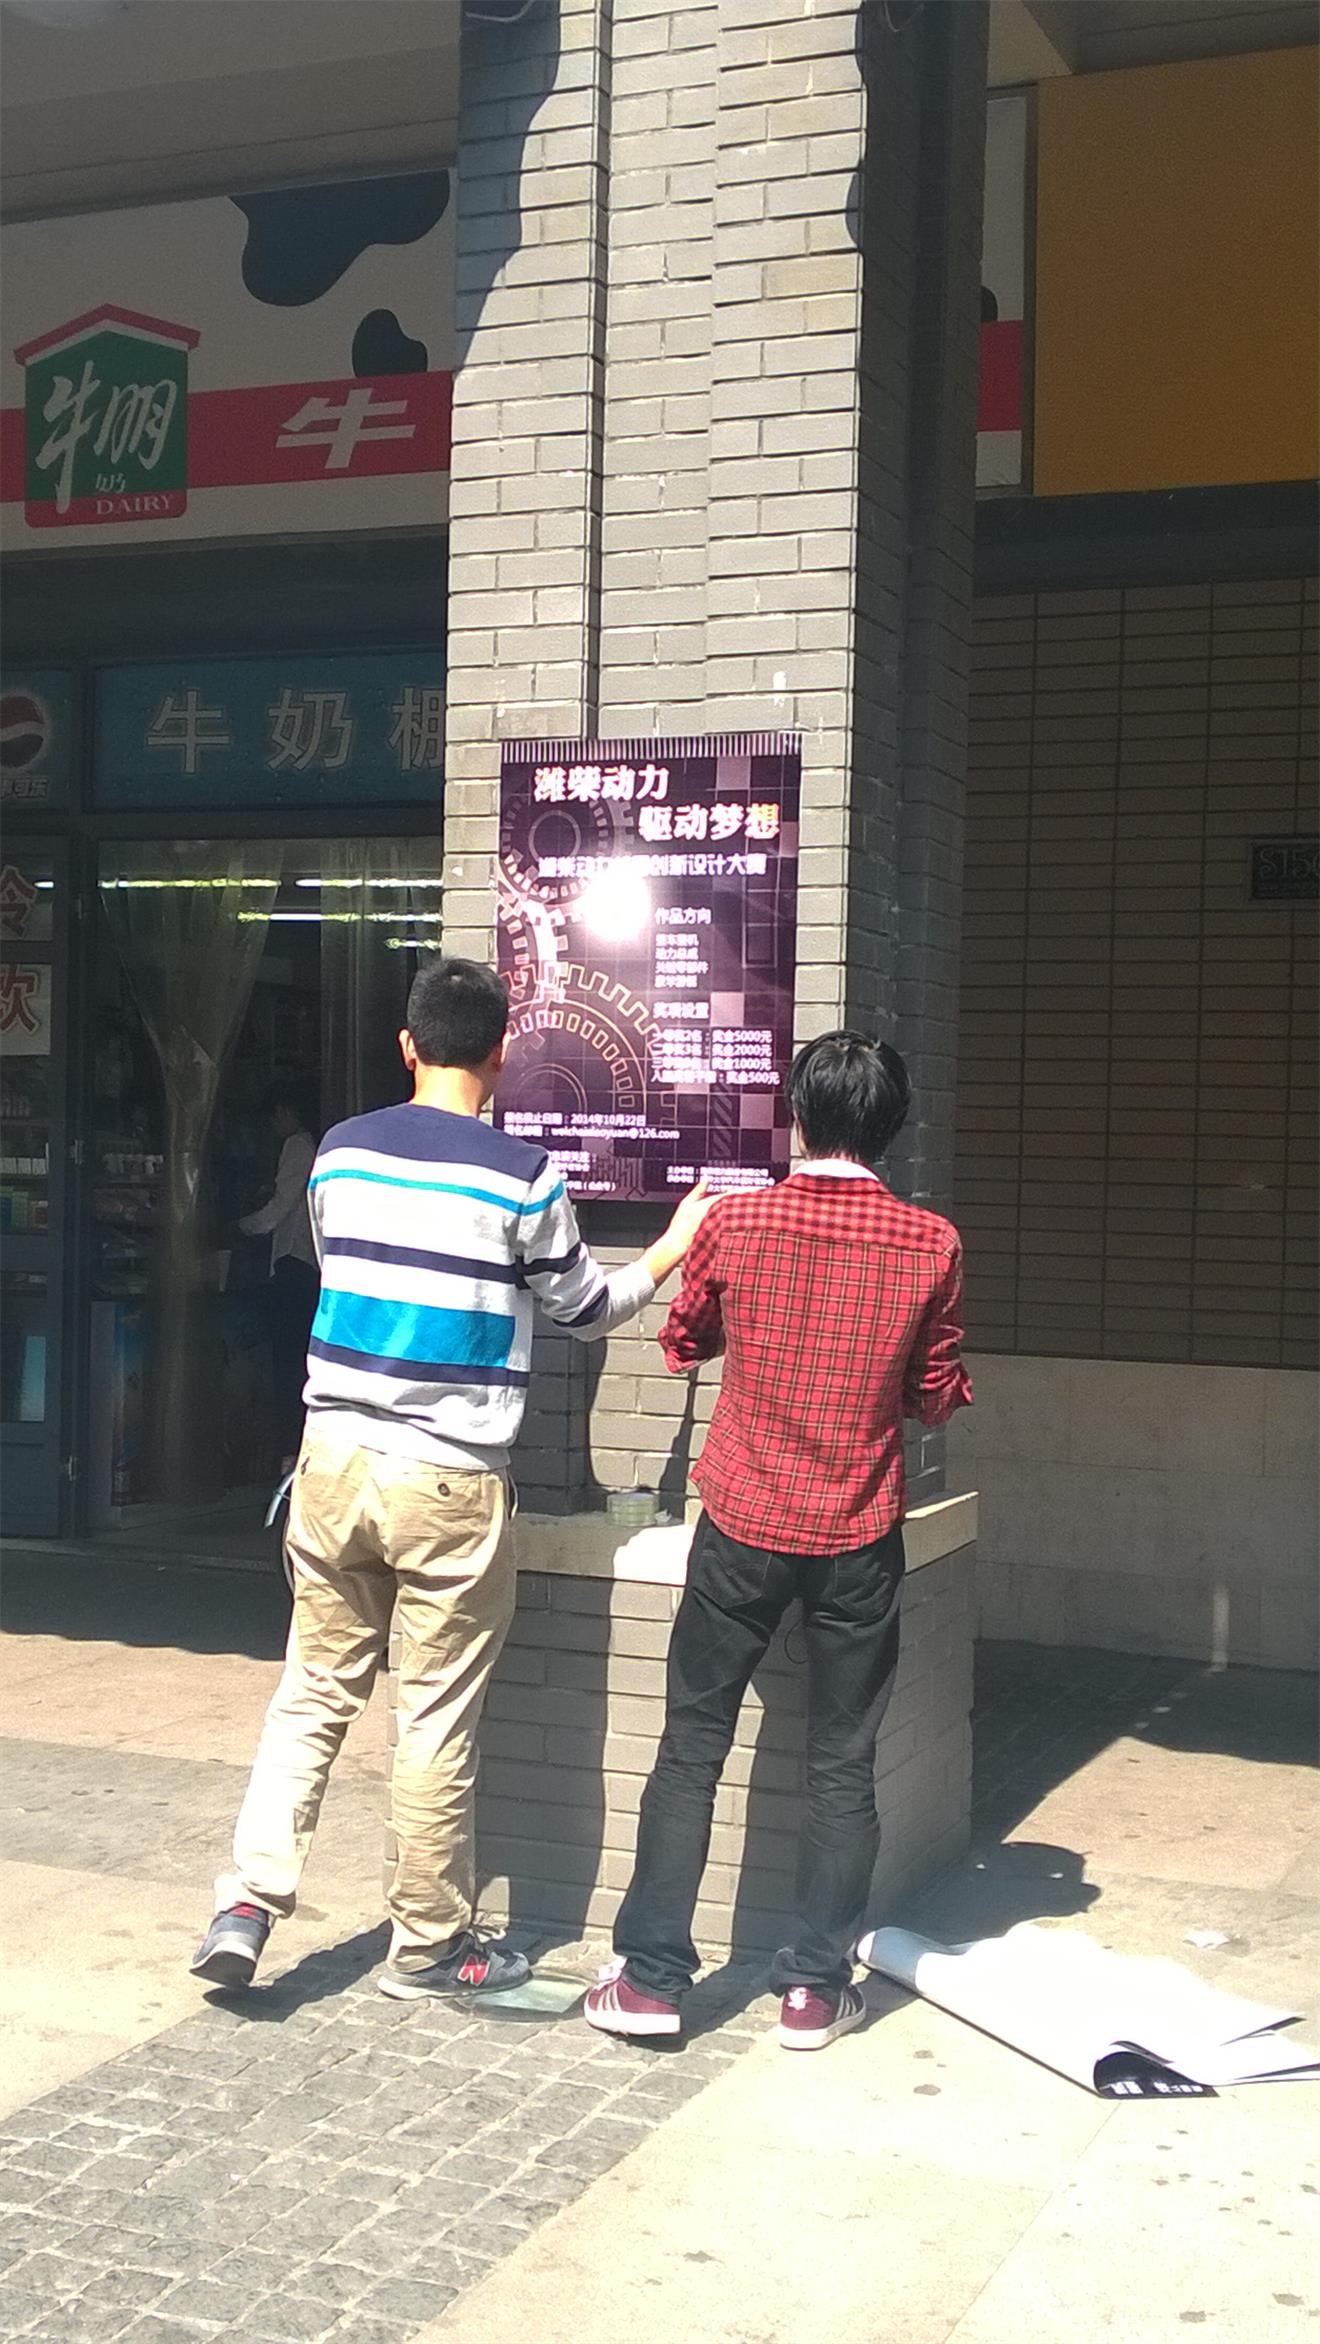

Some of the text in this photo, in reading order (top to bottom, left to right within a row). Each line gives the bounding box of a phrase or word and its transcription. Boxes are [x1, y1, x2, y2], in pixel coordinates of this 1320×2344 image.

[274, 387, 417, 470] 牛
[95, 494, 174, 516] DAIRY
[534, 764, 670, 803] 潍柴动力
[638, 803, 781, 842] 驱动梦想
[654, 907, 712, 925] 作品方向
[652, 1001, 709, 1019] 奖项设置
[457, 1952, 491, 1987] N
